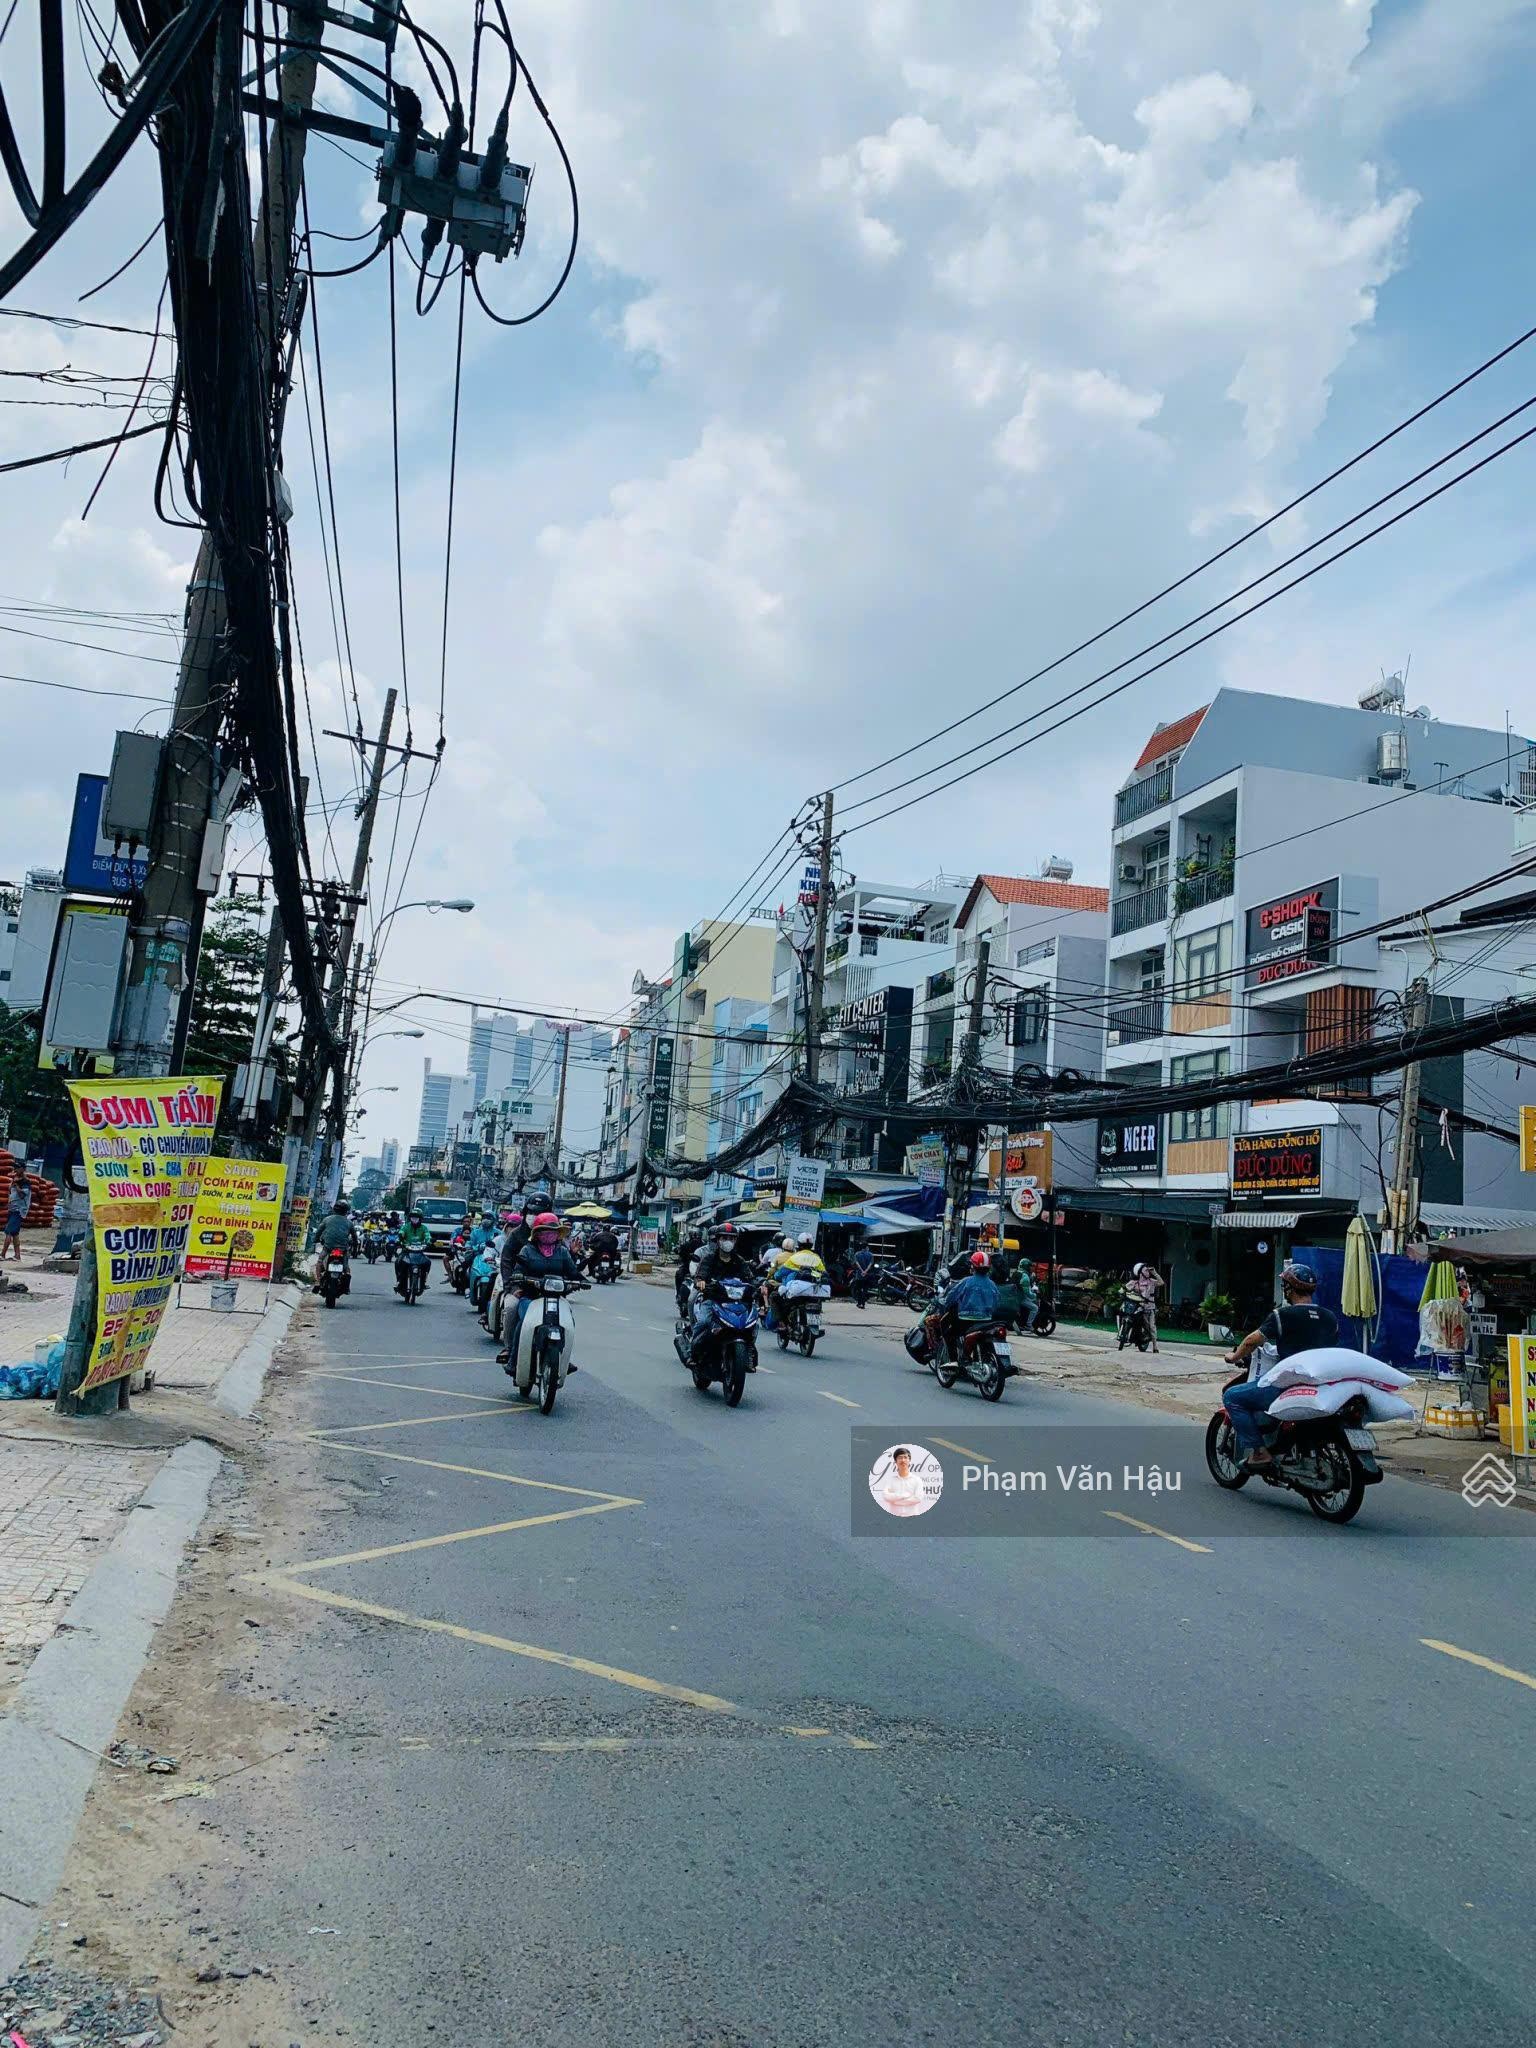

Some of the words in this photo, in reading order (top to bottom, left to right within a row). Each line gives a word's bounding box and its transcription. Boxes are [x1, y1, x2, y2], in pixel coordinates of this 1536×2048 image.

[92, 857, 112, 871] ĐIỂM
[80, 1096, 158, 1130] CƠM
[158, 1085, 216, 1128] TẤM
[94, 1160, 129, 1178] SƯỜN
[142, 1159, 156, 1177] BÌ
[108, 1181, 143, 1198] SƯỜN
[204, 1177, 229, 1187] CƠM
[232, 1178, 254, 1190] TẤM
[197, 1215, 223, 1226] CƠM
[225, 1216, 249, 1229] BÌNH
[251, 1219, 273, 1231] DÂN
[104, 1225, 158, 1254] CƠM
[110, 1254, 156, 1284] BÌNH
